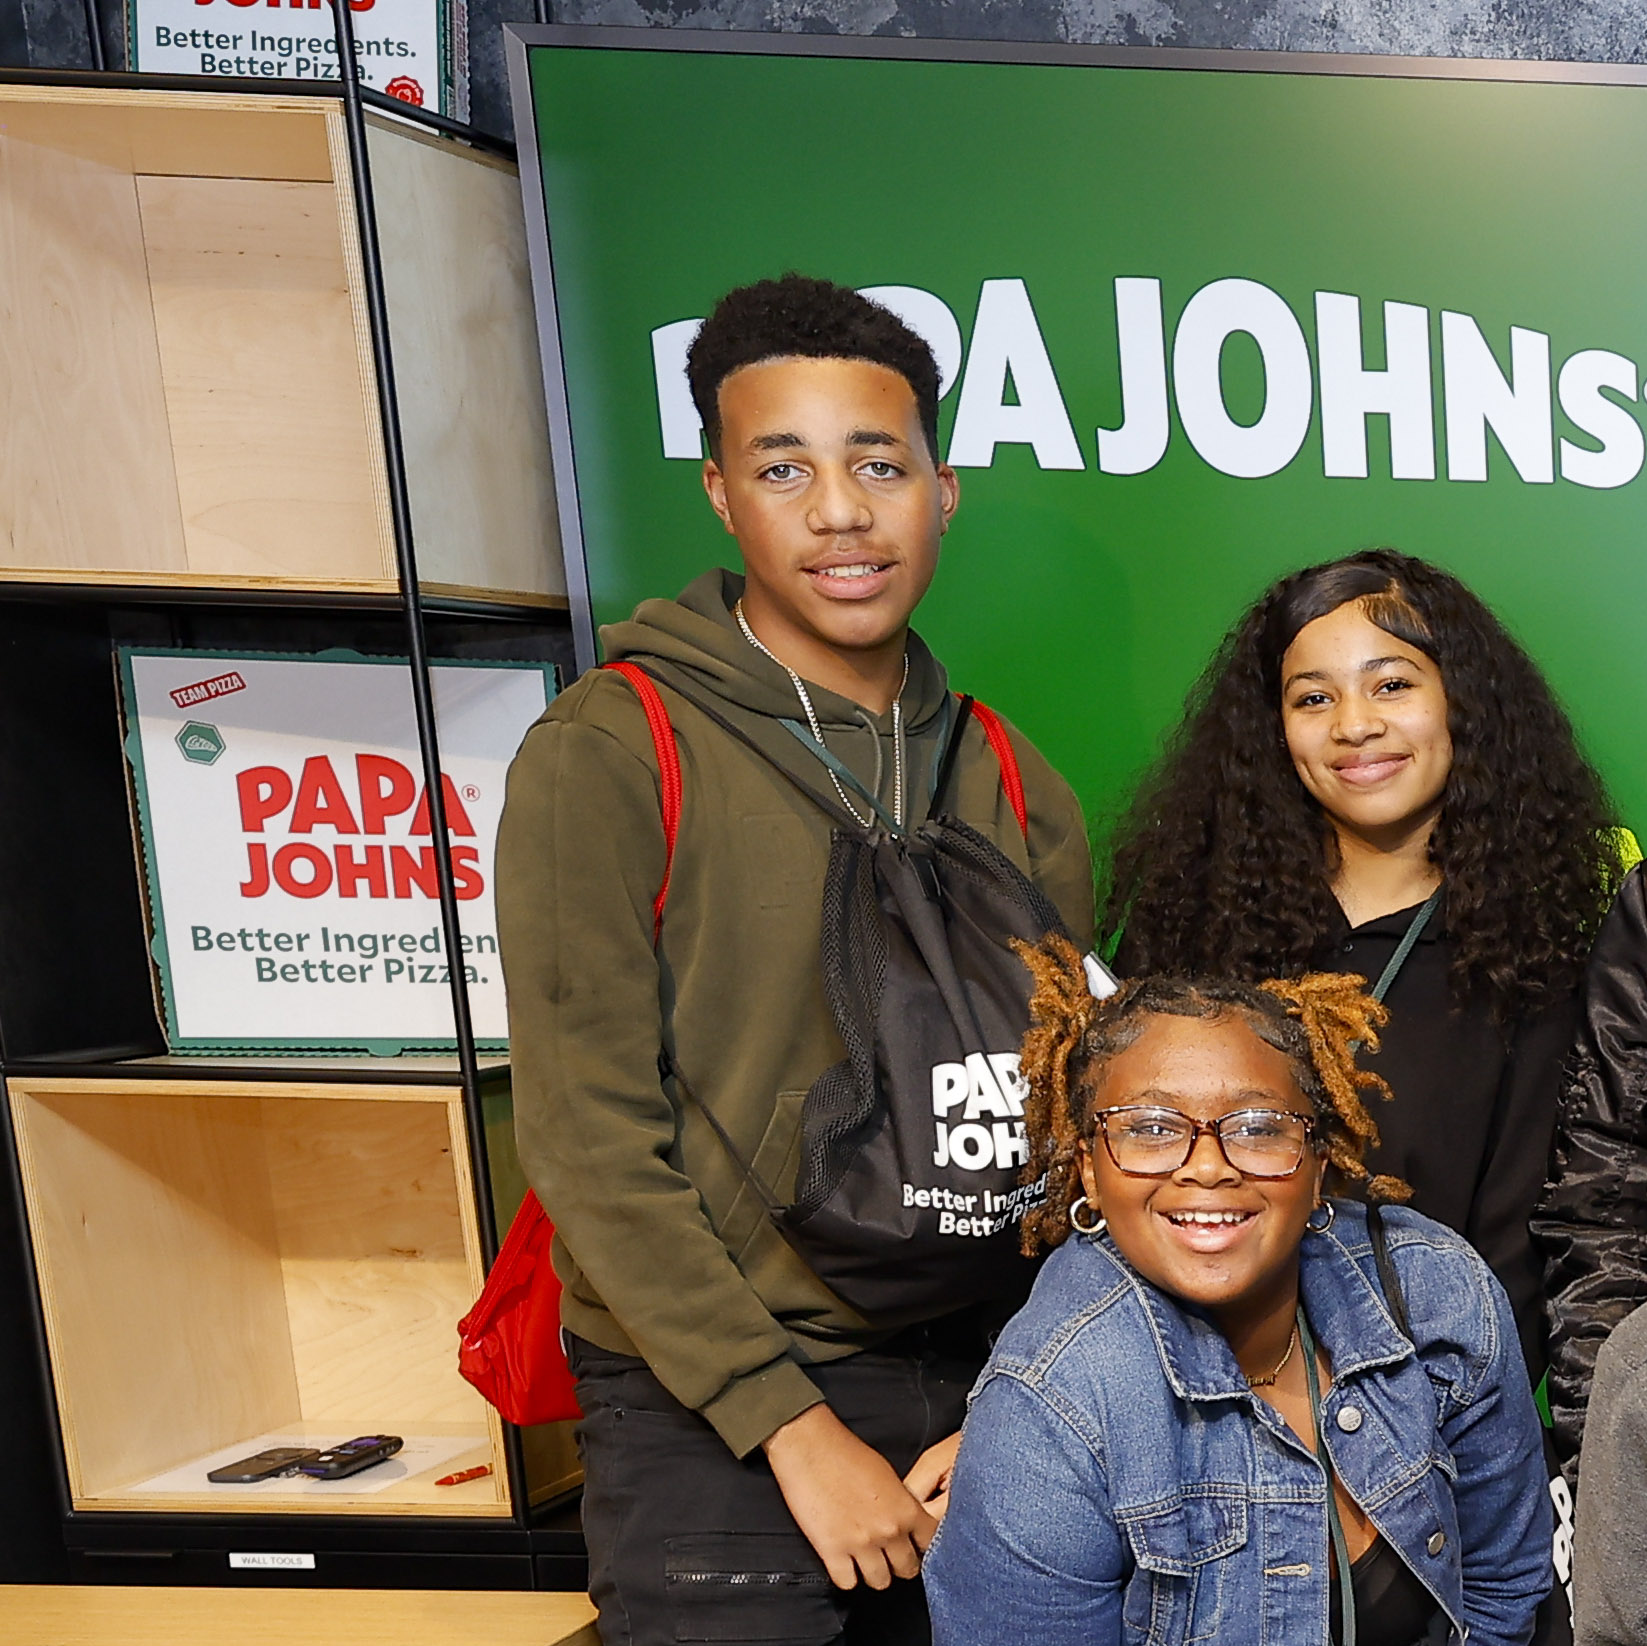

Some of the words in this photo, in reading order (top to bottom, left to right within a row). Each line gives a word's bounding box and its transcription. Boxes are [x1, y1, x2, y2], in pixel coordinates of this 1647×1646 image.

[154, 26, 243, 51] Better
[251, 30, 417, 58] Ingreents.
[200, 53, 288, 78] Better
[295, 55, 374, 81] Piza.
[172, 684, 210, 707] TEAM
[206, 674, 243, 697] PIZZA
[239, 841, 485, 901] JOHNS
[191, 925, 311, 952] Better
[321, 926, 497, 959] Ingreden
[255, 957, 375, 983] Better
[932, 1052, 1032, 1120] PAP
[933, 1121, 1031, 1172] JOH
[903, 1183, 978, 1214] Better
[938, 1211, 1010, 1238] Better
[240, 1556, 268, 1565] WALL
[270, 1556, 303, 1566] TOOLS
